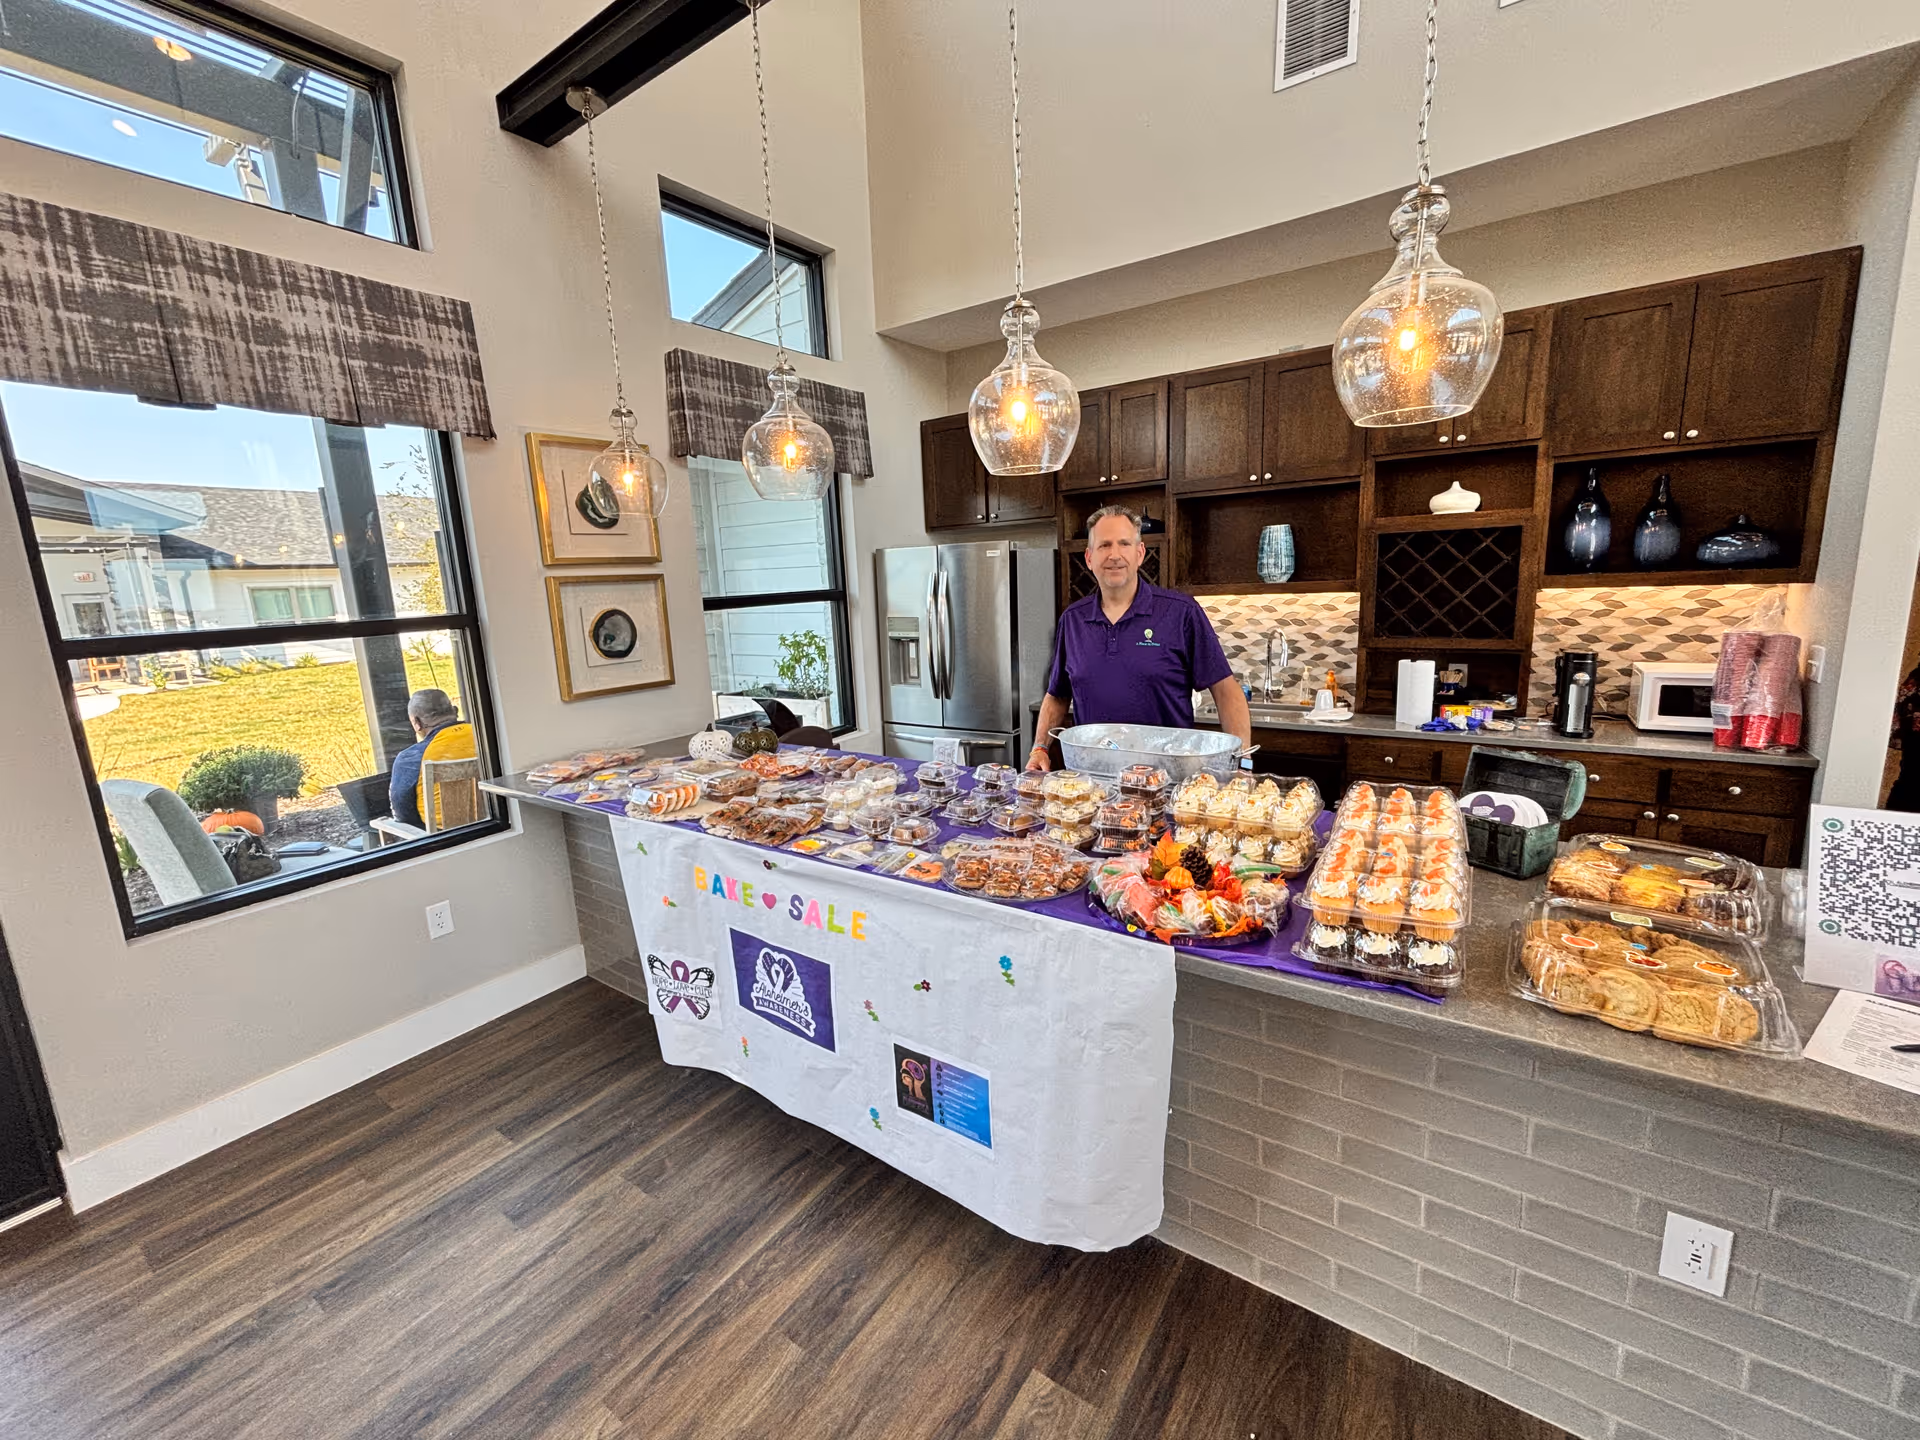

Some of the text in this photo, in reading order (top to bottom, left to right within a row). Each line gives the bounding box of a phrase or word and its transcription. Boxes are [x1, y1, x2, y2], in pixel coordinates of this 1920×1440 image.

[694, 866, 867, 941] BAKE SALE
[759, 998, 806, 1027] AWARENESS
